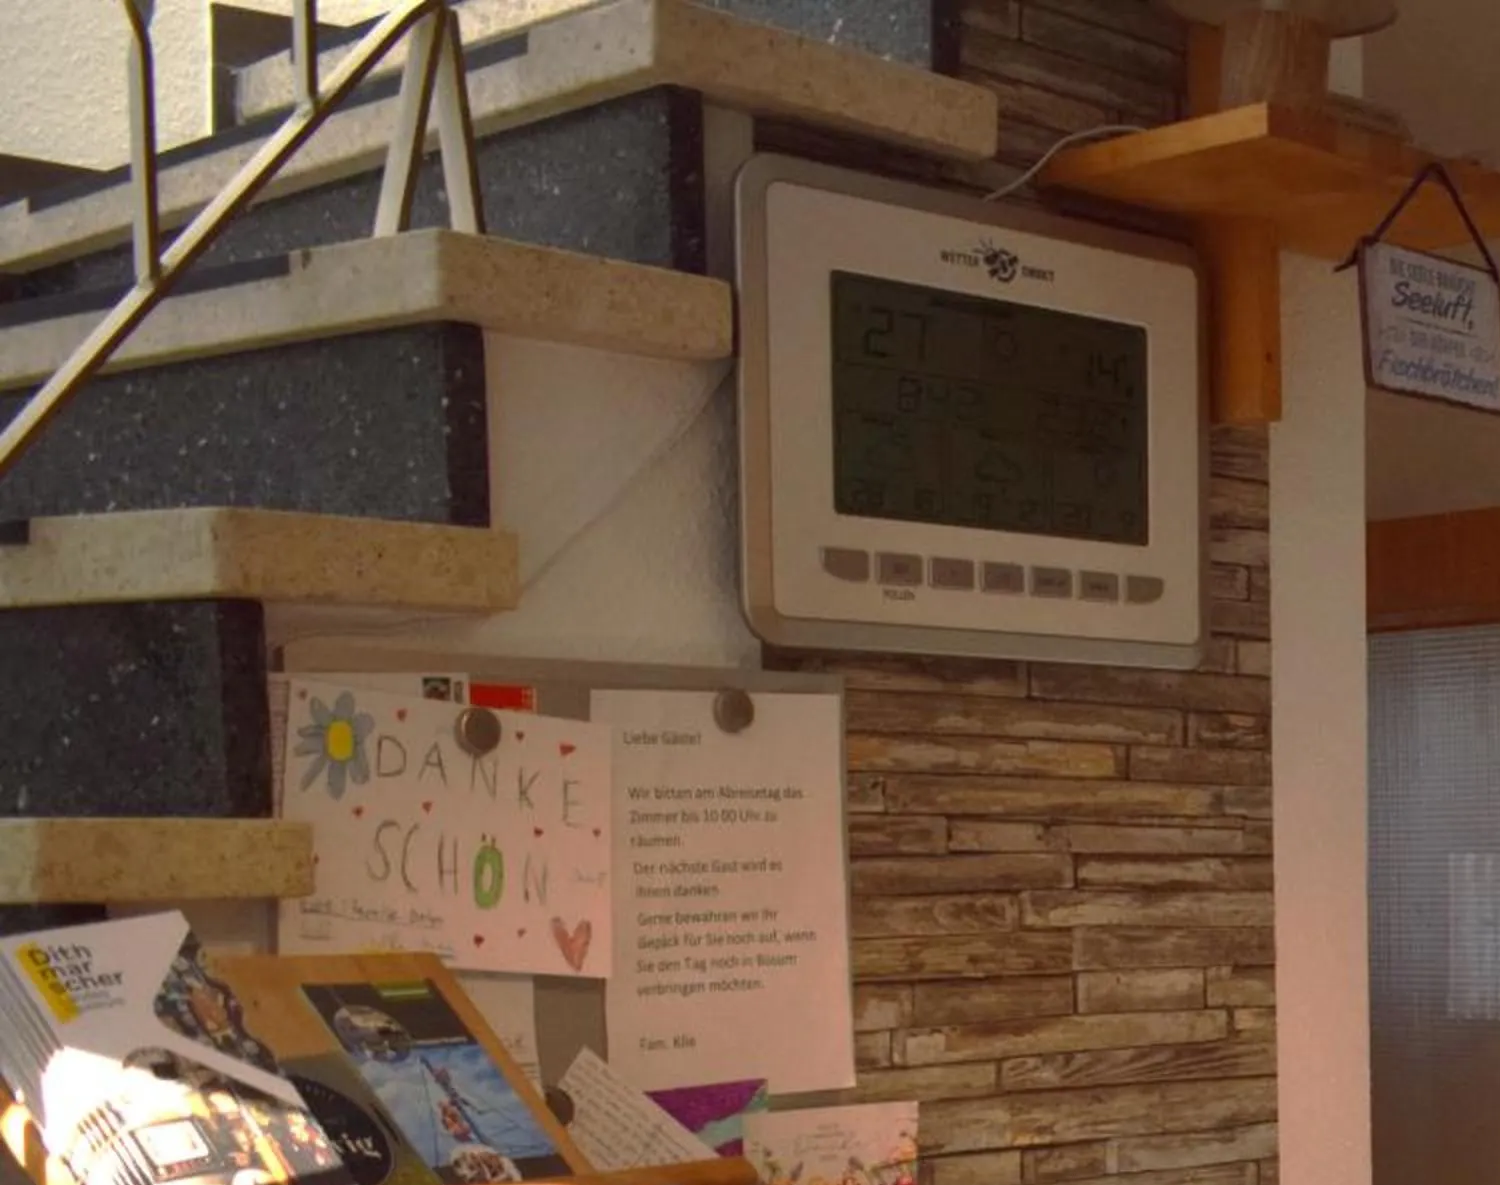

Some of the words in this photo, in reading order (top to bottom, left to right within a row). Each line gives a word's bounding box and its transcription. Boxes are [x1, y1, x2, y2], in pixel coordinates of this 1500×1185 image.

[623, 731, 658, 745] Liebe
[376, 734, 582, 828] DANKE
[628, 786, 650, 800] Wir
[654, 786, 692, 800] bitten
[695, 788, 715, 800] am
[718, 785, 782, 802] Abreisetag
[783, 785, 804, 800] das
[630, 809, 678, 824] Zimmer
[681, 809, 699, 823] bis
[739, 809, 760, 823] Uhr
[764, 811, 777, 822] zu
[630, 835, 685, 848] räumen.
[366, 819, 549, 910] SCHÖN
[633, 862, 655, 875] Der
[659, 860, 709, 874] nächste
[711, 859, 738, 873] Gast
[741, 858, 767, 872] wird
[769, 860, 783, 872] es
[636, 886, 670, 898] Ihnen
[637, 912, 672, 926] Gerne
[675, 911, 737, 925] bewahren
[741, 910, 759, 922] wir
[762, 908, 778, 921] Ihr
[638, 935, 679, 951] Gepäck
[683, 934, 703, 946] für
[705, 933, 725, 945] Sie
[726, 931, 755, 945] noch
[784, 930, 817, 942] wenn
[28, 943, 93, 967] Dith
[637, 960, 655, 973] Sie
[657, 958, 681, 971] den
[684, 957, 707, 973] Tag
[711, 955, 739, 969] noch
[742, 955, 754, 967] in
[40, 960, 93, 980] mar
[637, 981, 705, 997] verbringen
[709, 978, 765, 992] möchten.
